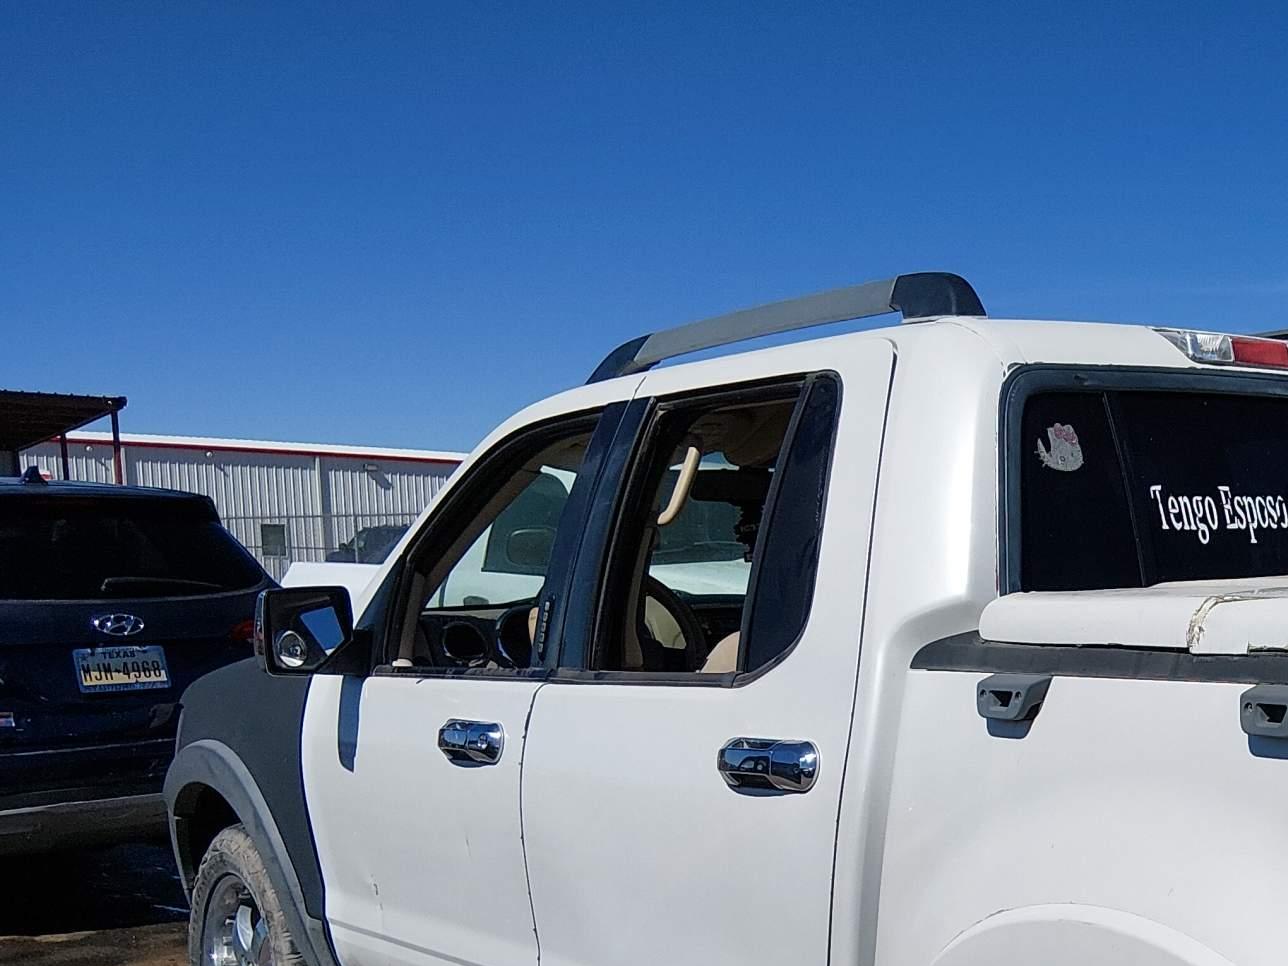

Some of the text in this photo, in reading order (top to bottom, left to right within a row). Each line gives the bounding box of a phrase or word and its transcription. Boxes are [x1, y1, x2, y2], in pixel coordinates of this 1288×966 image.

[1149, 484, 1219, 545] Tengo
[1217, 485, 1288, 544] Esposo
[101, 648, 136, 660] TEXAS
